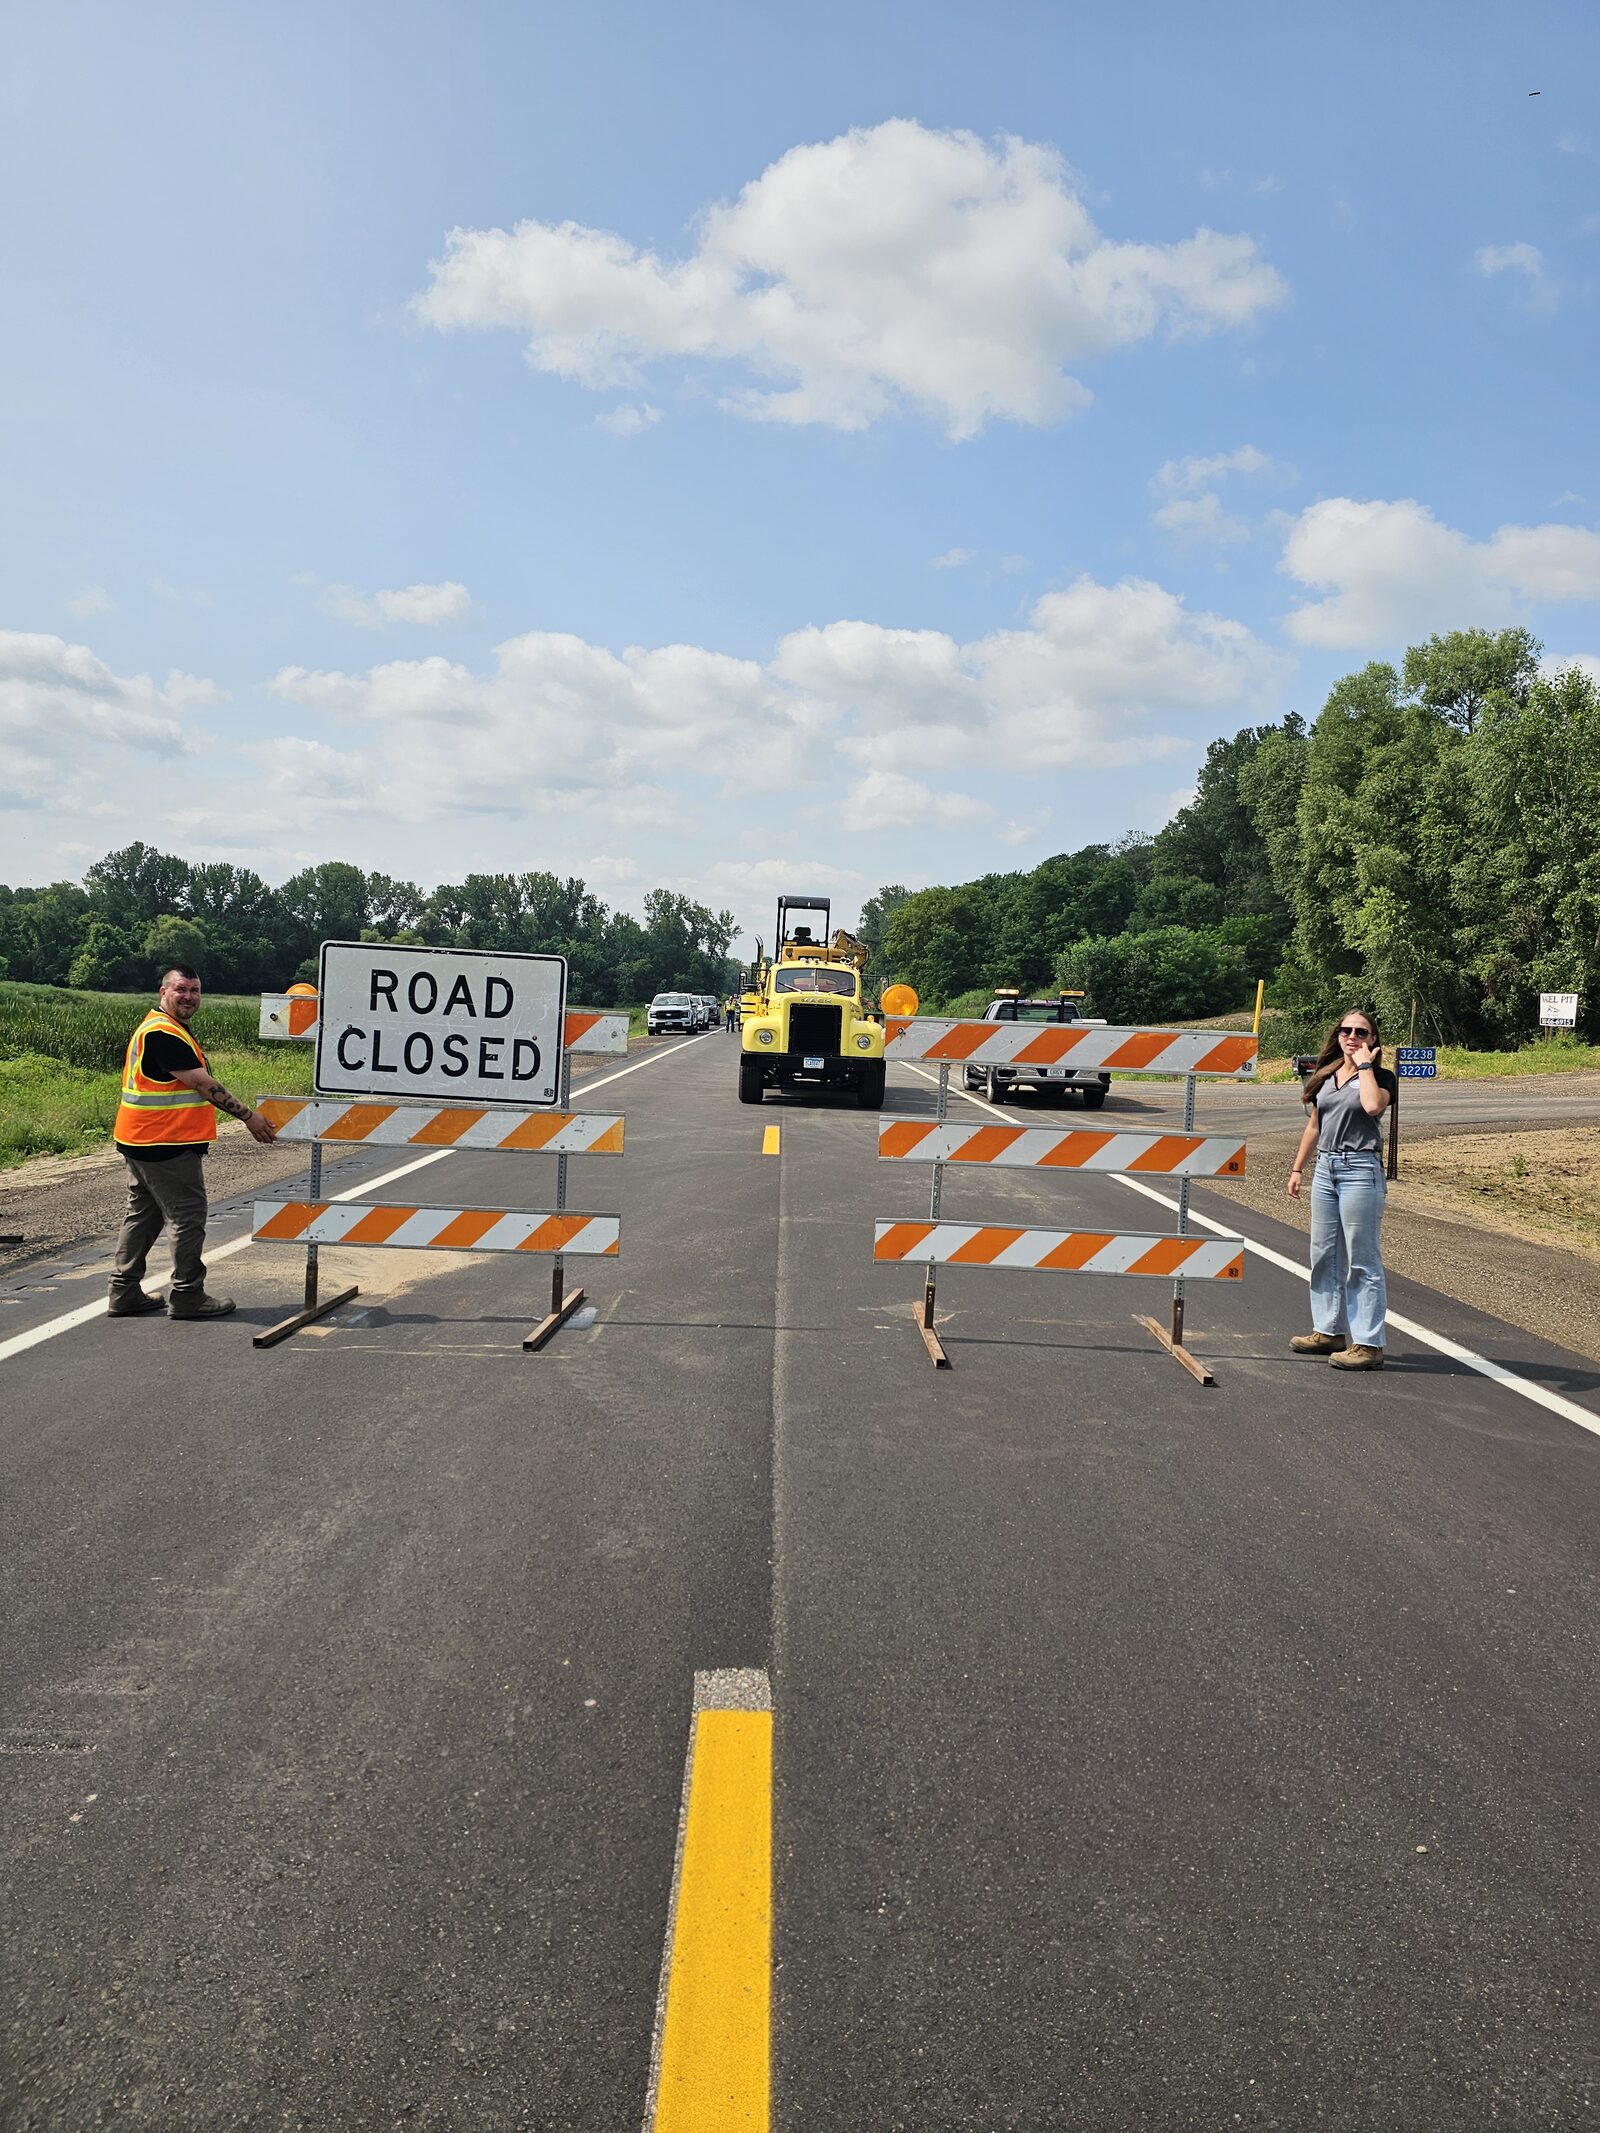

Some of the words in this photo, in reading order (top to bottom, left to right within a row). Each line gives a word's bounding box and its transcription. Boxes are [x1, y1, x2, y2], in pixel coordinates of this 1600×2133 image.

[370, 968, 514, 1019] ROAD
[1560, 995, 1575, 1004] PIT
[337, 1026, 541, 1081] CLOSED
[1400, 1049, 1433, 1060] 32238
[1401, 1065, 1435, 1076] 32270
